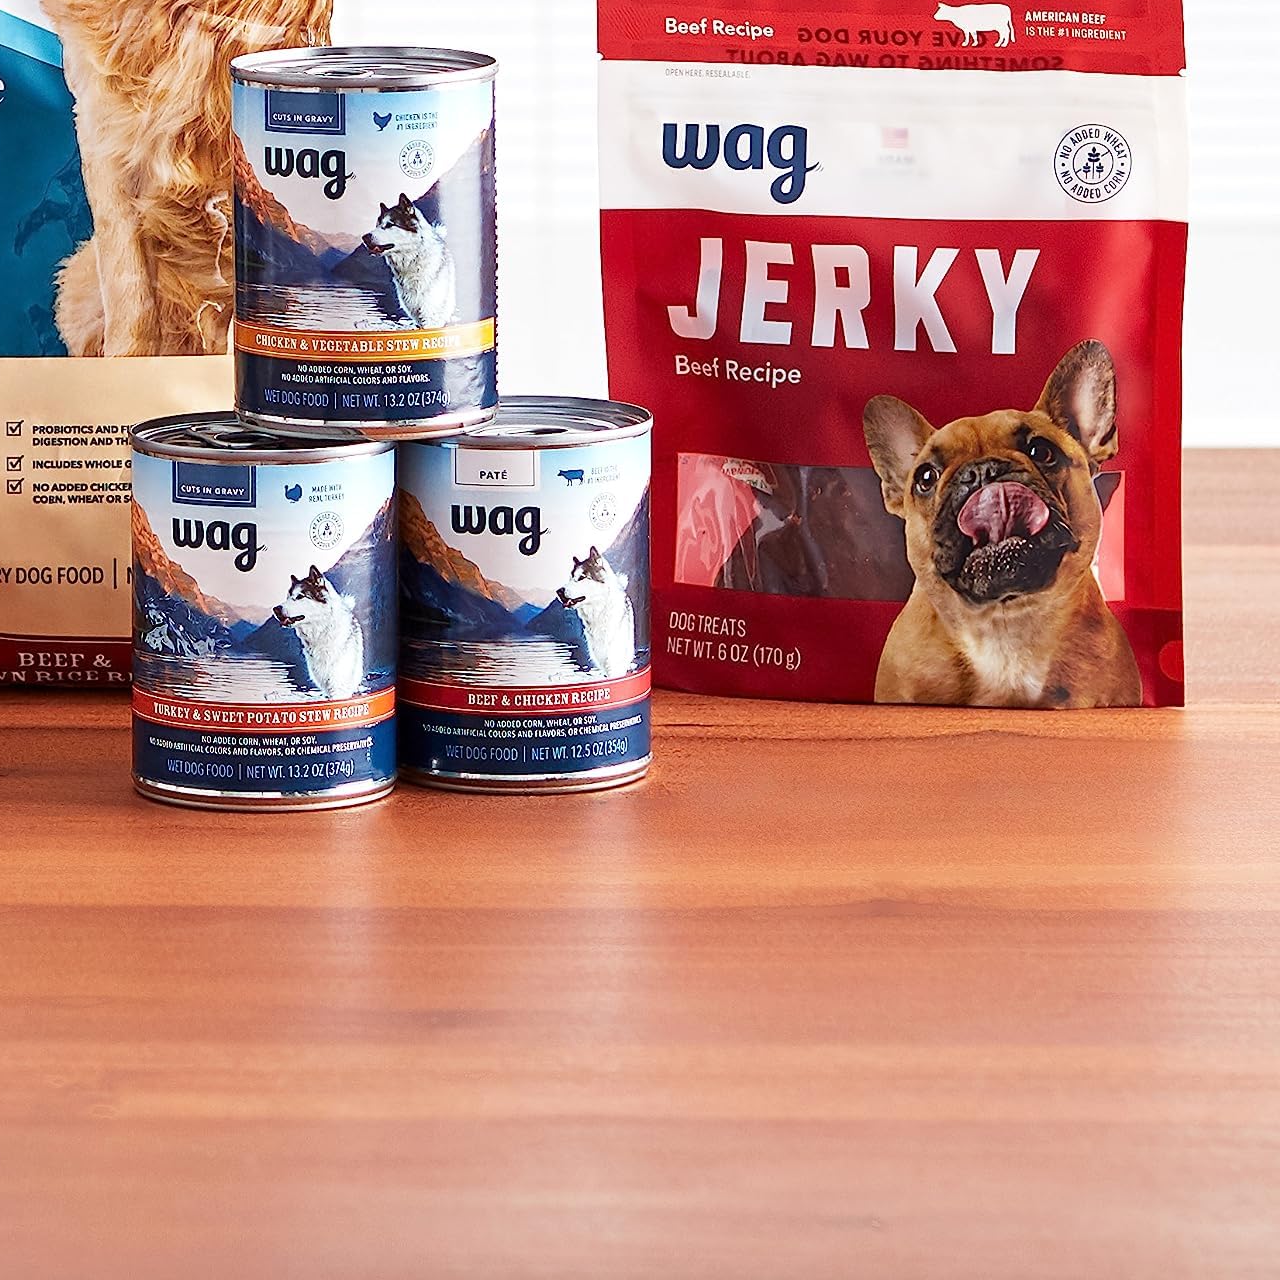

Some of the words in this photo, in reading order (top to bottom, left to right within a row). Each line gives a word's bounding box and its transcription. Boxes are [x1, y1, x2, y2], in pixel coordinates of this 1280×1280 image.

[1025, 11, 1079, 23] AMERICAN
[1082, 13, 1106, 24] BEEF
[665, 17, 707, 34] Beef
[712, 19, 774, 40] Recipe
[1026, 27, 1035, 36] IS
[1038, 27, 1055, 37] THE
[1058, 29, 1069, 37] #1
[1072, 29, 1126, 40] INGREDIENT
[272, 112, 293, 121] CUTS
[295, 113, 304, 122] IN
[306, 114, 333, 123] GRAVY
[1060, 145, 1072, 159] NO
[1070, 128, 1100, 146] ADDED
[1104, 131, 1127, 158] WHEAT
[264, 145, 356, 200] wag
[662, 123, 824, 204] wag
[1060, 170, 1073, 184] NO
[1071, 184, 1101, 199] ADDED
[1104, 170, 1125, 193] CORN
[667, 237, 1040, 354] JERKY
[256, 334, 297, 349] CHICKEN
[299, 340, 308, 350] &
[312, 340, 383, 352] VEGETABLE
[386, 338, 419, 351] STEW
[675, 354, 719, 378] Beef
[726, 359, 801, 385] Recipe
[264, 389, 281, 403] WET
[282, 390, 300, 404] DOG
[302, 392, 329, 407] FOOD
[342, 394, 360, 408] NET
[363, 394, 381, 407] WT.
[384, 393, 404, 407] 13.2
[408, 391, 420, 406] OZ
[422, 389, 451, 407] (374g)
[32, 426, 94, 434] PROBIOTICS
[95, 426, 118, 434] AND
[33, 438, 88, 446] DIGESTION
[90, 438, 113, 446] AND
[32, 461, 82, 469] INCLUDES
[85, 460, 122, 468] WHOLE
[480, 470, 507, 479] PATÉ
[33, 484, 49, 492] NO
[51, 483, 88, 491] ADDED
[181, 485, 200, 493] CUTS
[202, 486, 211, 494] IN
[215, 486, 245, 496] GRAVY
[33, 495, 65, 504] CORN,
[68, 495, 104, 504] WHEAT
[106, 495, 122, 503] OR
[451, 503, 551, 555] wag
[172, 517, 267, 572] wag
[16, 567, 52, 585] DOG
[58, 567, 104, 585] FOOD
[670, 612, 695, 631] DOG
[698, 615, 746, 637] TREATS
[667, 637, 691, 656] NET
[694, 642, 714, 659] WT.
[718, 643, 727, 660] 6
[731, 645, 748, 662] OZ
[754, 646, 782, 667] (170
[786, 647, 801, 670] g)
[469, 694, 498, 706] BEEF
[502, 695, 510, 706] &
[514, 693, 569, 706] CHICKEN
[572, 688, 610, 703] RECIPE
[153, 702, 189, 718] TURKEY
[193, 709, 201, 720] &
[204, 710, 244, 723] SWEET
[247, 711, 296, 723] POTATO
[299, 708, 331, 722] STEW
[334, 704, 369, 720] RECIPE
